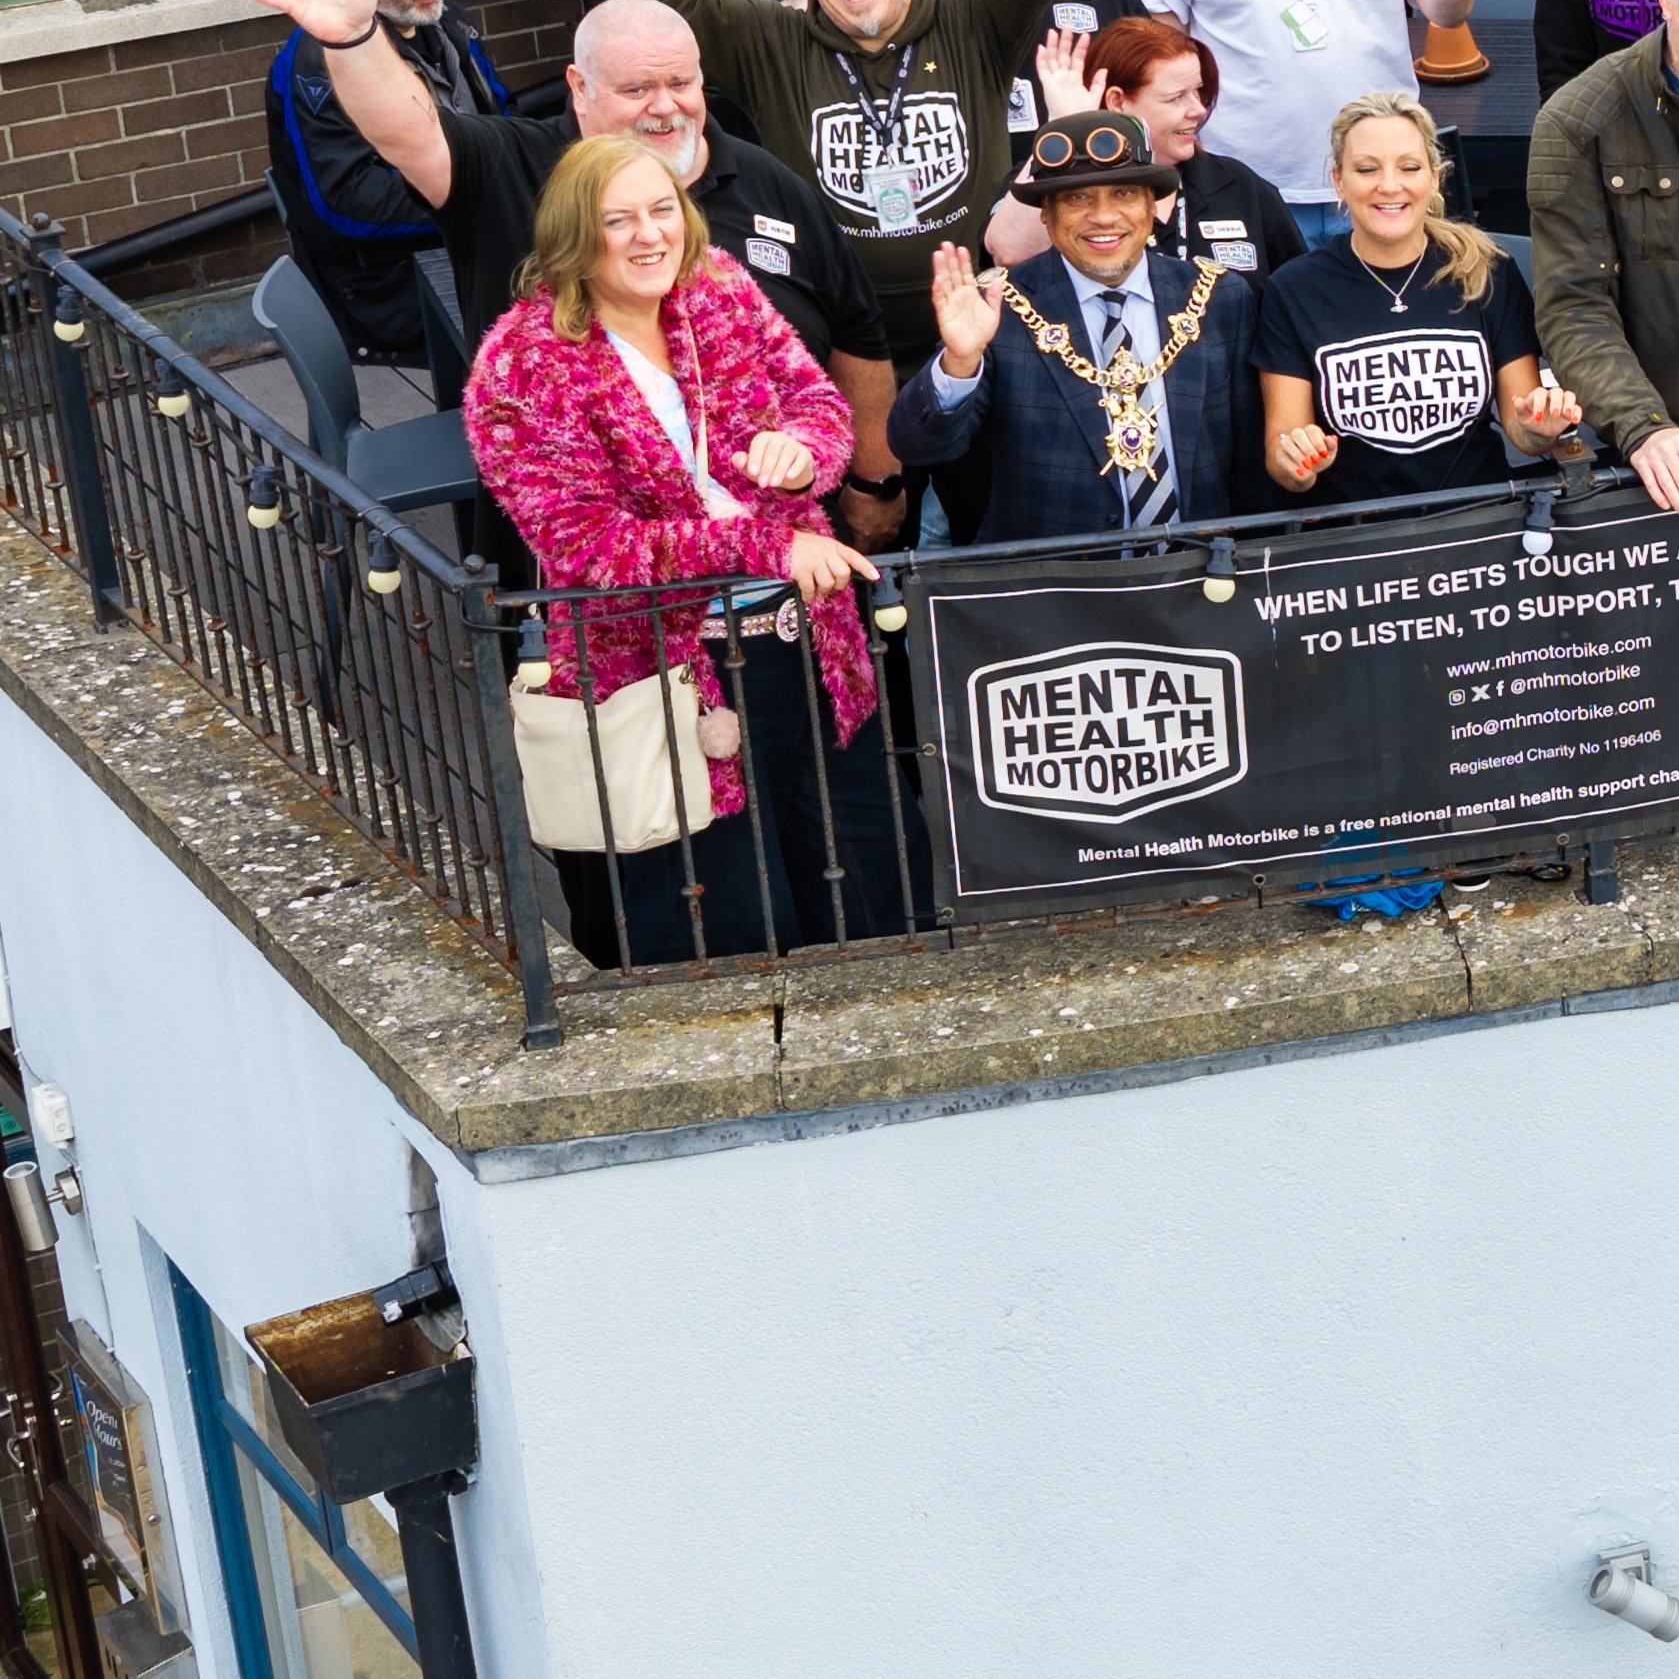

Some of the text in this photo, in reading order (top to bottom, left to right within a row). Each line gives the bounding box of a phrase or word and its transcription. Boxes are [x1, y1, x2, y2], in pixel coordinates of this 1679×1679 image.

[1058, 8, 1092, 17] MENTAL
[1599, 3, 1664, 30] MOTOR
[829, 110, 952, 145] METAL
[831, 157, 957, 194] MOBIKE
[751, 244, 784, 258] MENTAL
[1336, 348, 1476, 384] MENTAL
[1337, 375, 1479, 410] HEALTH
[1341, 401, 1478, 435] MOTORBIKE
[1254, 587, 1348, 620] WHEN
[1356, 577, 1420, 607] LIFE
[1428, 563, 1507, 596] GETS
[1513, 549, 1615, 581] TOUGH
[1623, 540, 1669, 568] WE
[1301, 630, 1342, 655] TO
[1351, 613, 1464, 648] LISTEN,
[1470, 604, 1511, 630] TO
[1517, 583, 1662, 621] SUPPORT,
[1446, 635, 1652, 678] www.mhmotorbike.com
[1000, 668, 1212, 721] MENTAL
[1510, 664, 1641, 696] @mhmotorbike
[1003, 709, 1215, 758] HEALTH
[1450, 695, 1655, 739] info@mhmotorbike.com
[1006, 742, 1217, 795] MOTORBIKE
[1449, 728, 1663, 777] Registered Charity No 1196406
[1078, 843, 1140, 864] Mental
[1144, 835, 1203, 858] Health
[1207, 825, 1299, 849] Motorbike
[1304, 823, 1319, 837] is
[1324, 824, 1335, 835] a
[1340, 816, 1375, 833] free
[1379, 805, 1452, 828] national
[1455, 795, 1516, 817] mental
[1520, 785, 1573, 808] health
[1578, 775, 1645, 801] support
